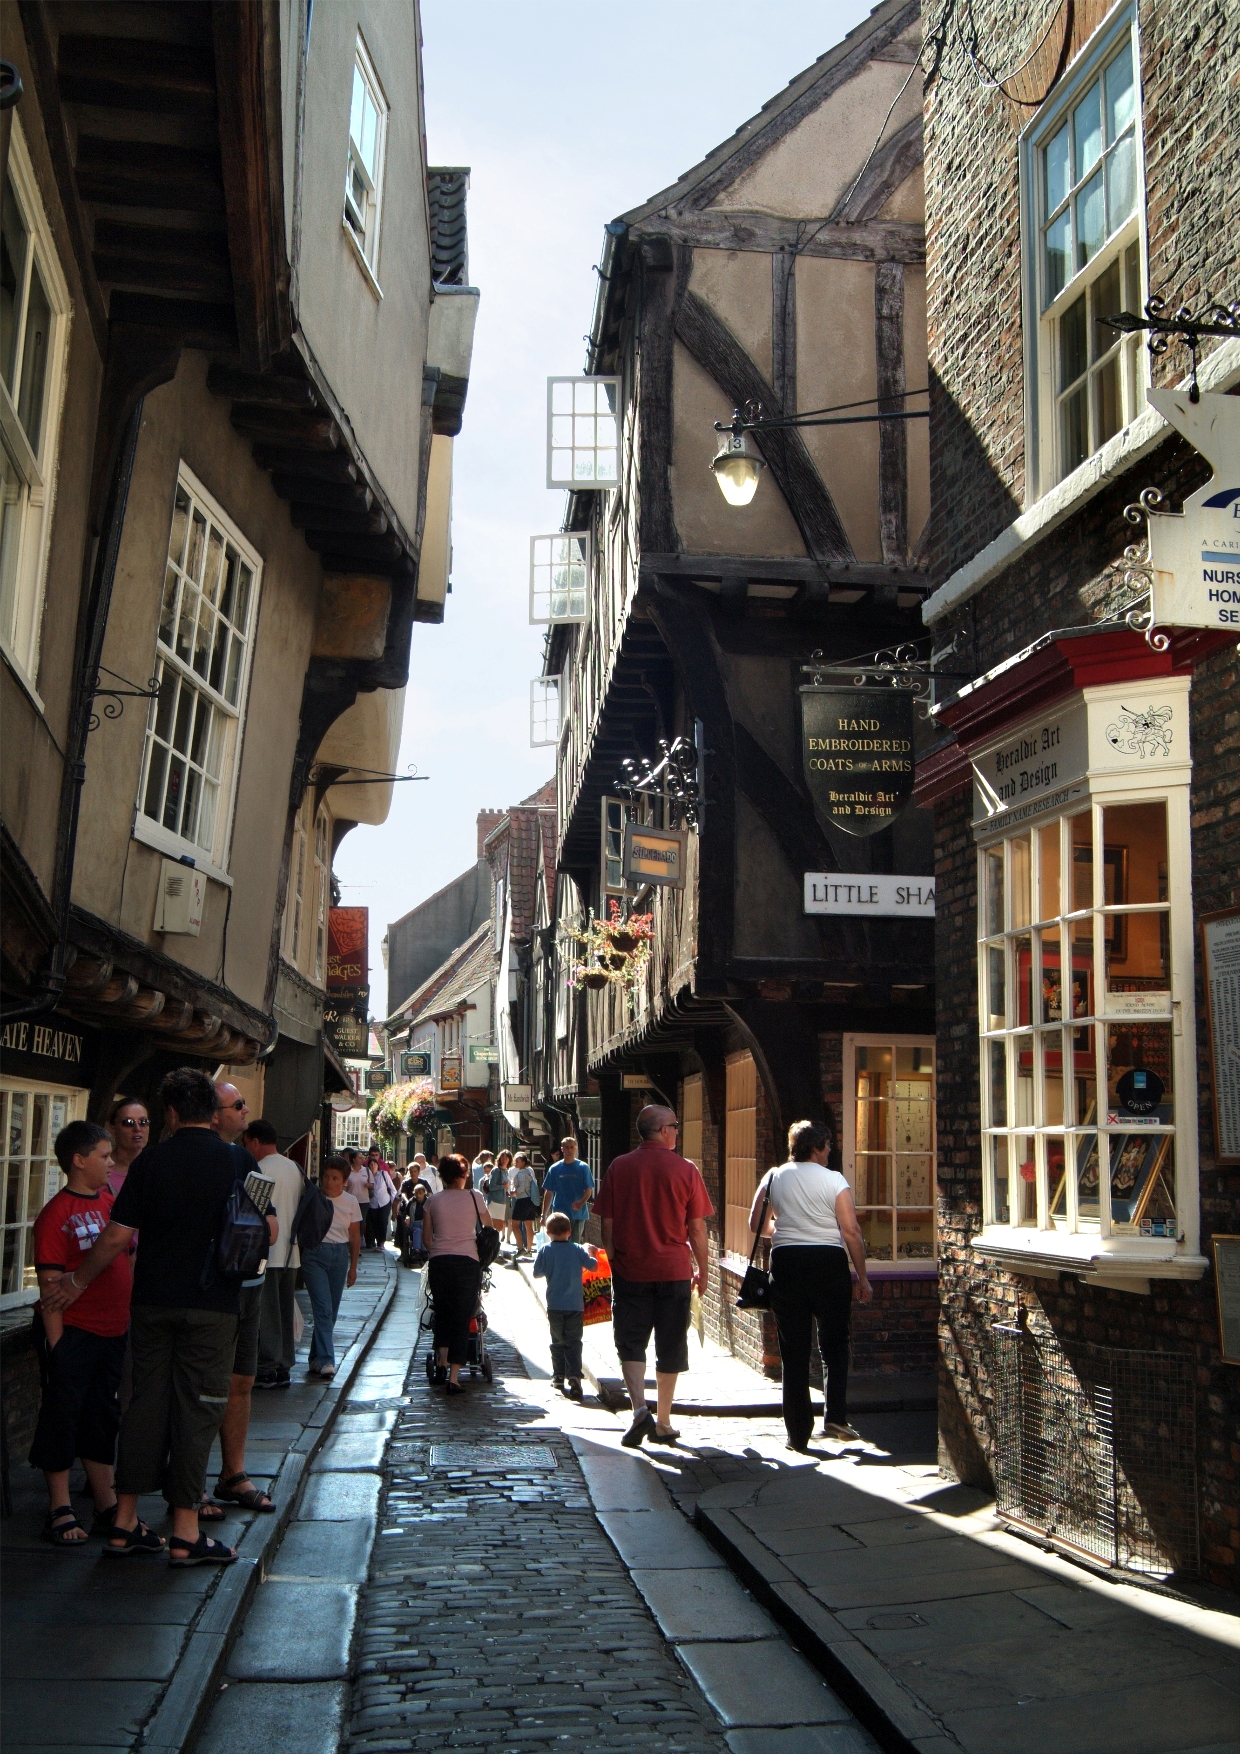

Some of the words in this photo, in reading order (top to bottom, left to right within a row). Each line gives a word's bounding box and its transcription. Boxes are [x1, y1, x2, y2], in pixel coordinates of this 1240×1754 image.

[733, 438, 742, 449] 3
[1218, 609, 1240, 623] SE
[838, 718, 880, 731] HAND
[808, 739, 911, 752] EMBROIDERED
[996, 735, 1038, 777] Heraldic
[1041, 725, 1061, 752] Art
[809, 758, 854, 771] COATS
[872, 760, 912, 772] ARMS
[998, 778, 1016, 802] and
[1020, 761, 1058, 794] Design
[828, 791, 873, 802] Heraldic
[876, 791, 895, 802] Art
[832, 805, 851, 815] and
[855, 805, 892, 816] Design
[990, 813, 1012, 833] FAMILY
[1012, 806, 1032, 823] NAME
[1033, 789, 1070, 814] RESEARCH
[896, 887, 936, 905] SHA
[32, 1024, 83, 1063] HEAVEN
[1127, 1099, 1153, 1111] OPEN
